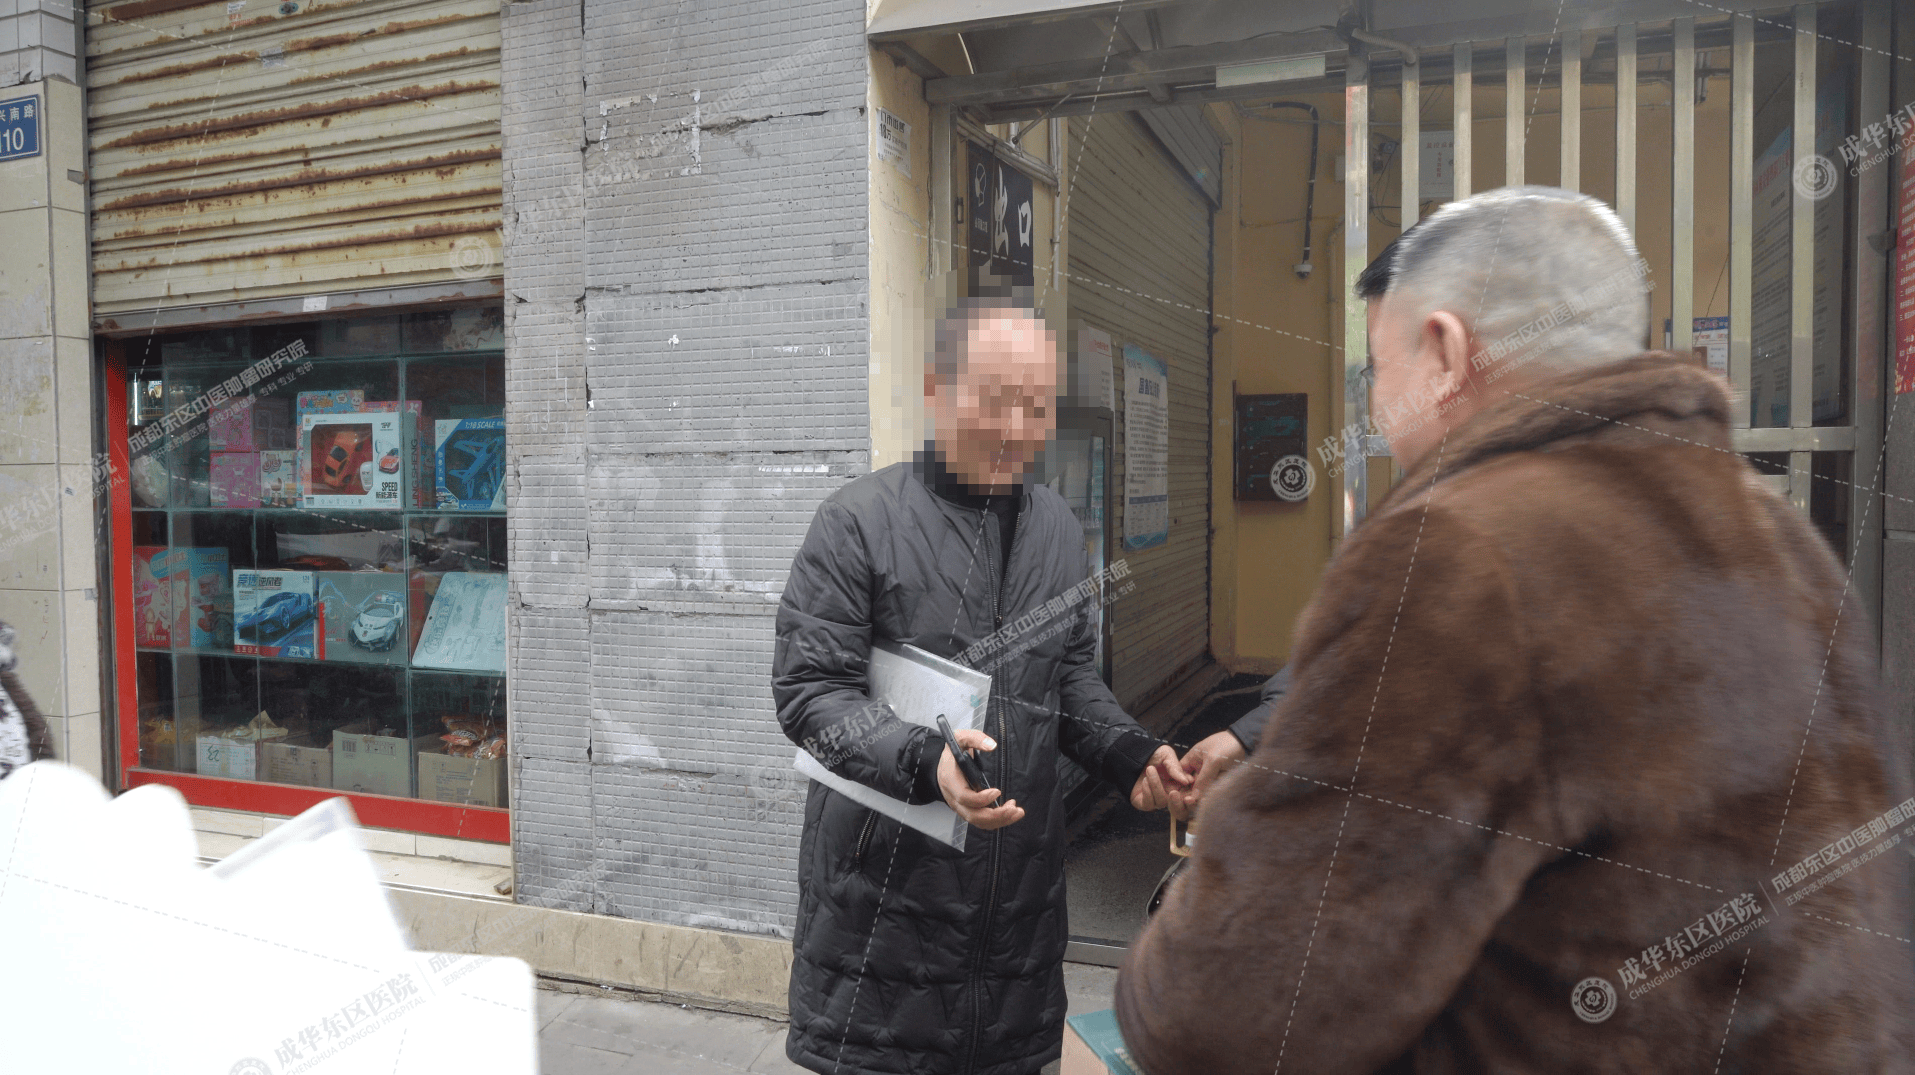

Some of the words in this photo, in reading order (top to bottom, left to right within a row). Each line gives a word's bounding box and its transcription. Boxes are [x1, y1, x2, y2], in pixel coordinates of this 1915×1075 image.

[0, 127, 24, 153] 10
[994, 163, 1032, 257] 出口
[382, 482, 398, 492] SPEED
